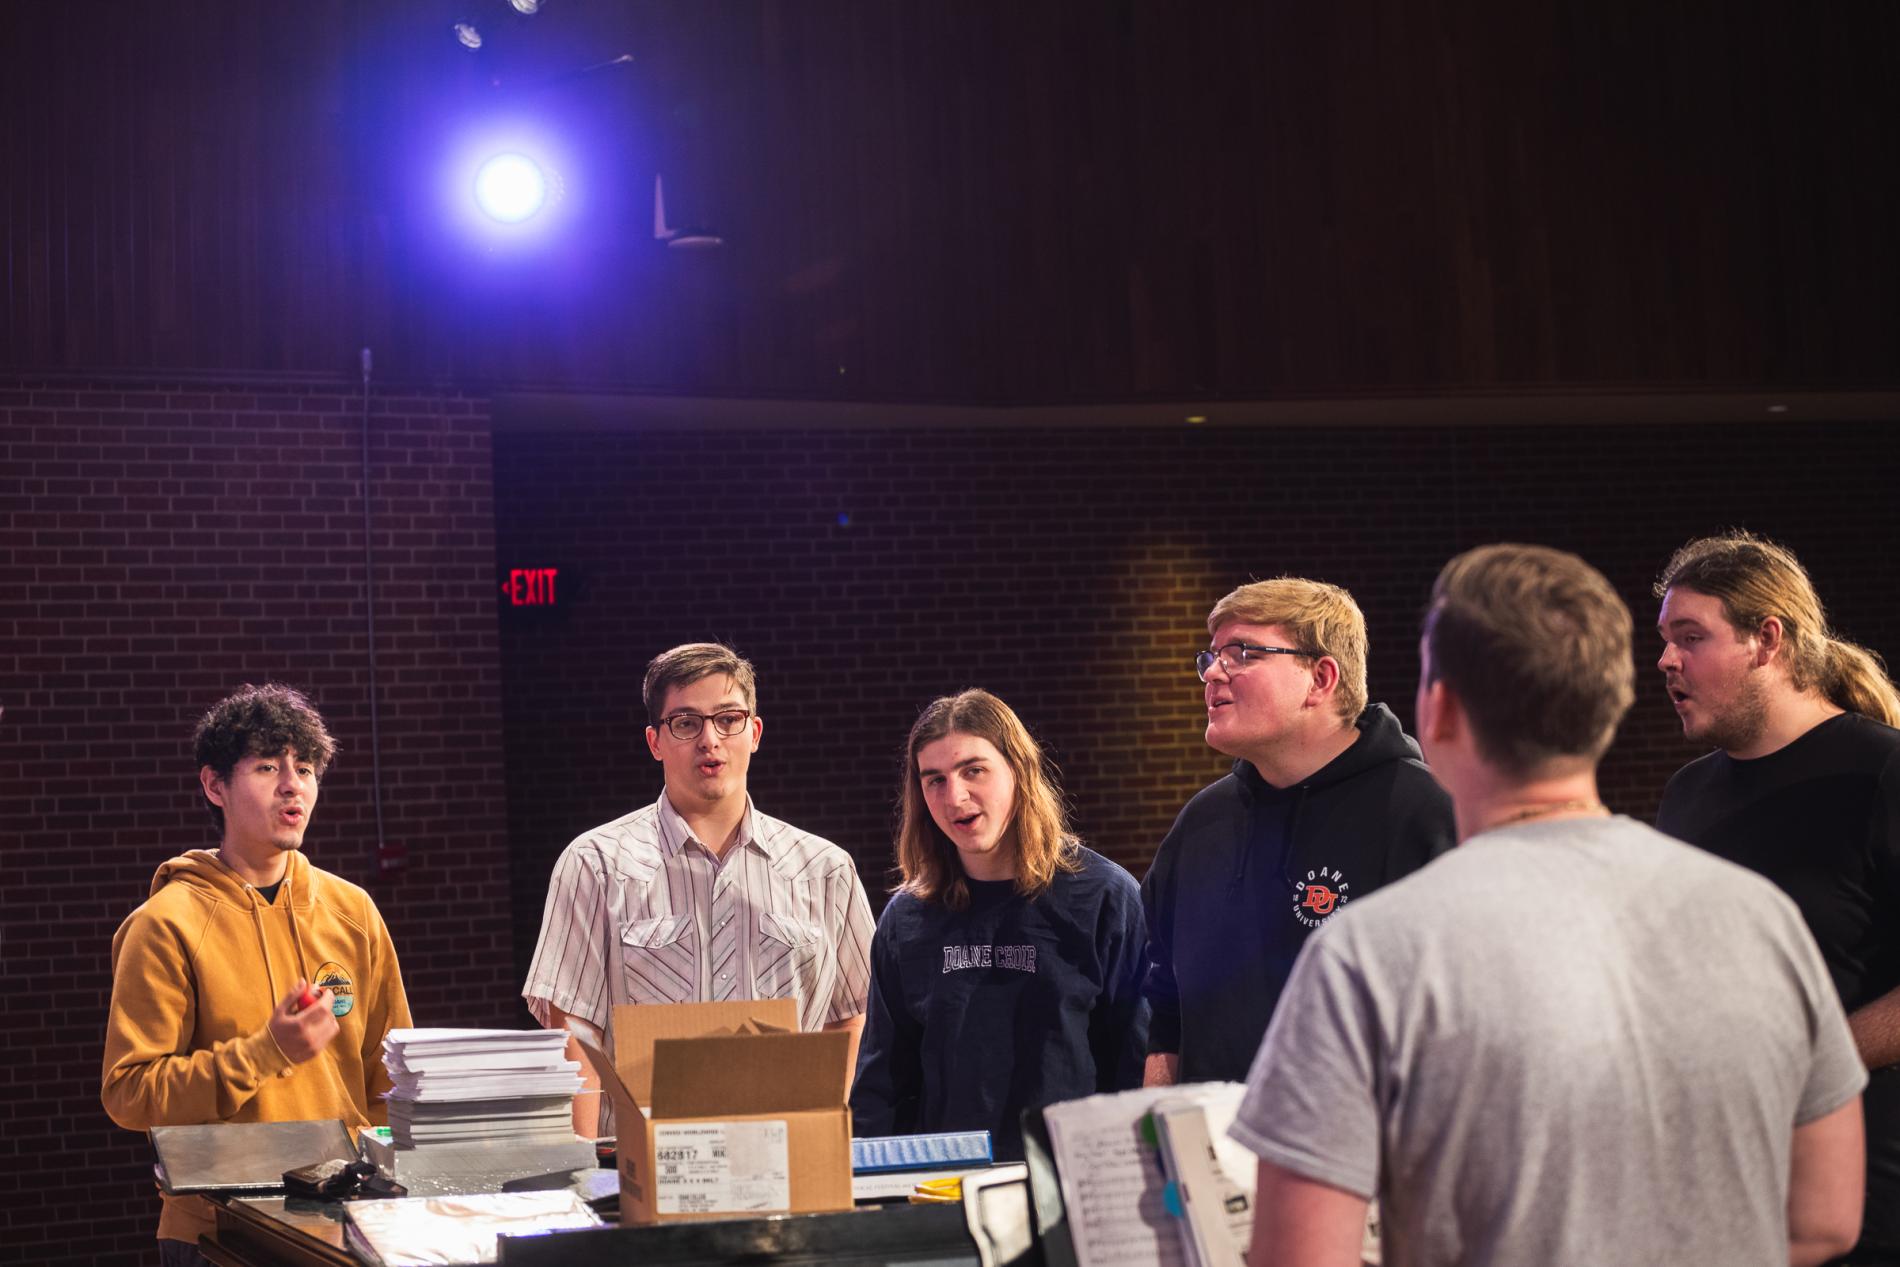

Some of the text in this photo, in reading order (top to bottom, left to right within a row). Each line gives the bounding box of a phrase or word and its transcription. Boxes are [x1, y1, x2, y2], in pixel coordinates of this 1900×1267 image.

[511, 568, 558, 605] EXIT
[1296, 866, 1349, 892] DOANE
[942, 945, 1037, 974] DOANE CHOIR
